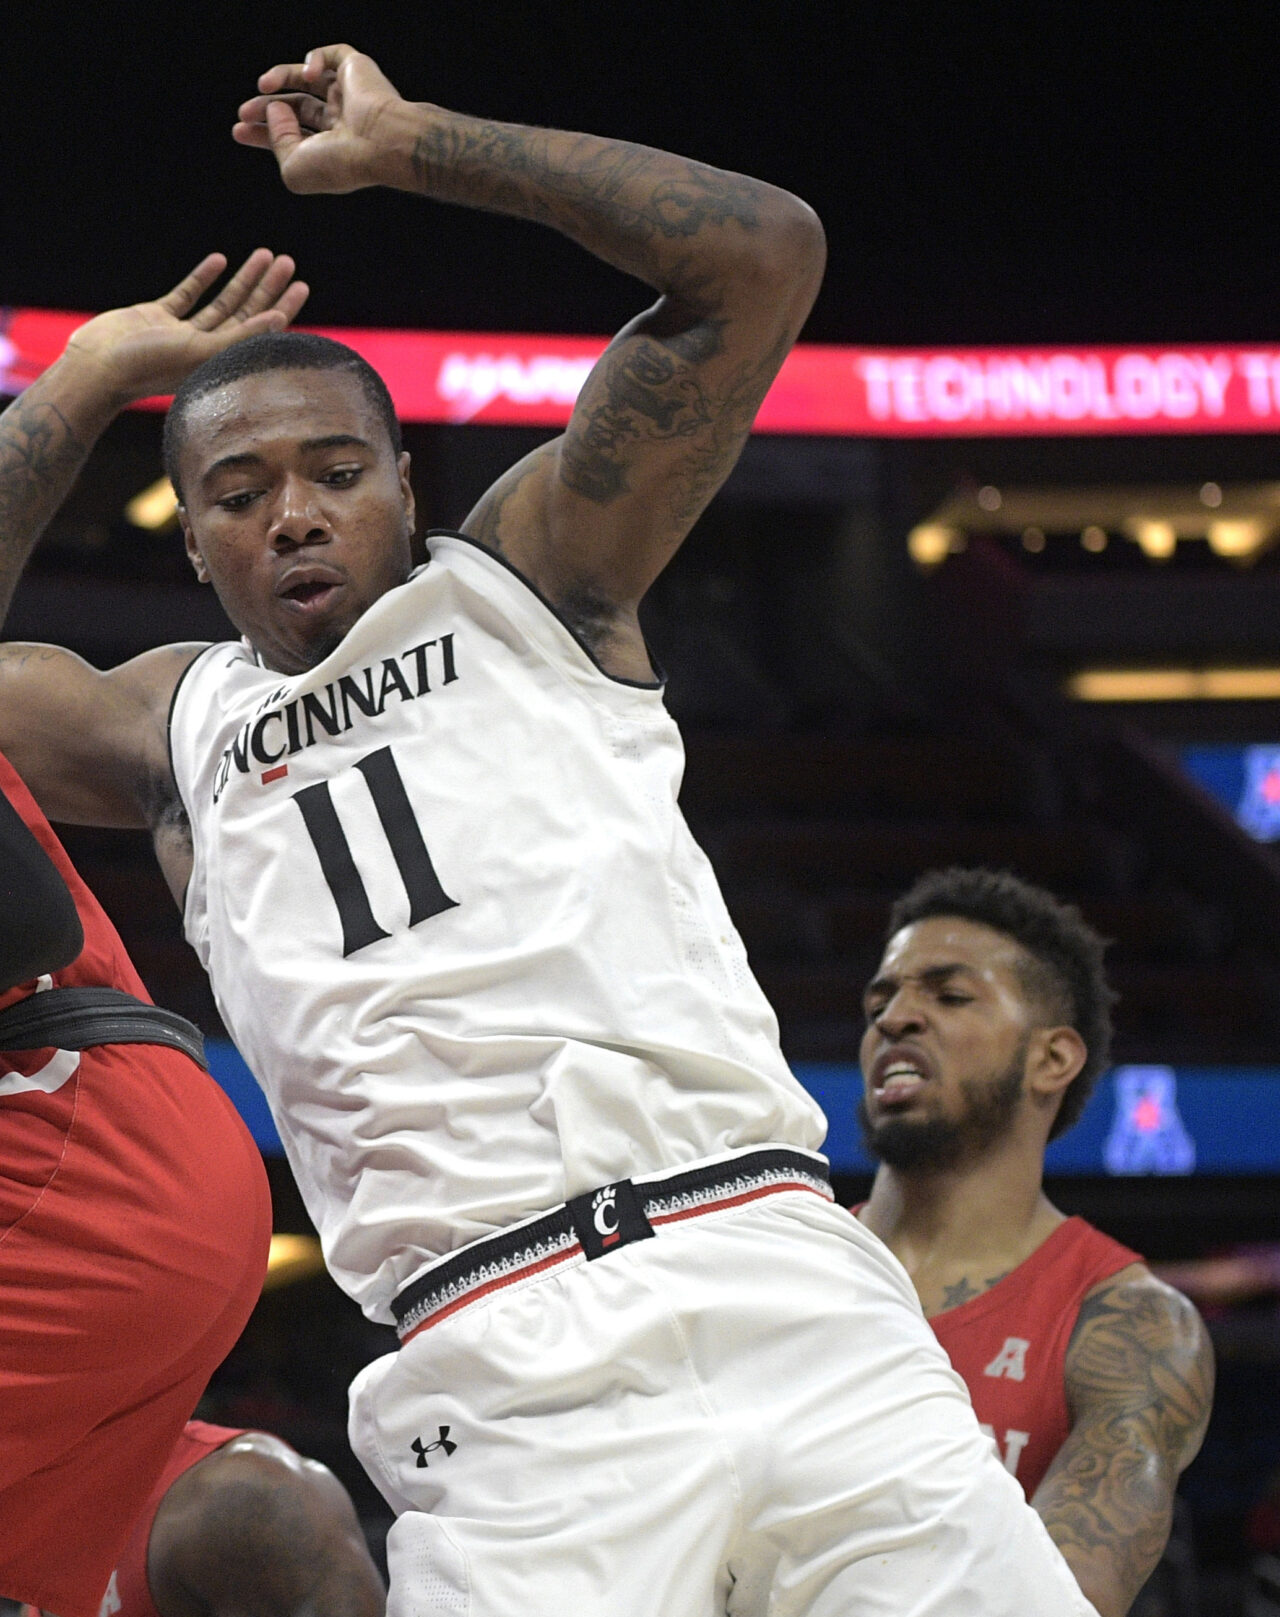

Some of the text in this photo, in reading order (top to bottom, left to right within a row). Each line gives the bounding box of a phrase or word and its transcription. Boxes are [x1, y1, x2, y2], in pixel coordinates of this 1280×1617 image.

[856, 353, 1280, 422] TECHNOLOGY T
[290, 745, 461, 959] 11
[983, 1336, 1031, 1382] A
